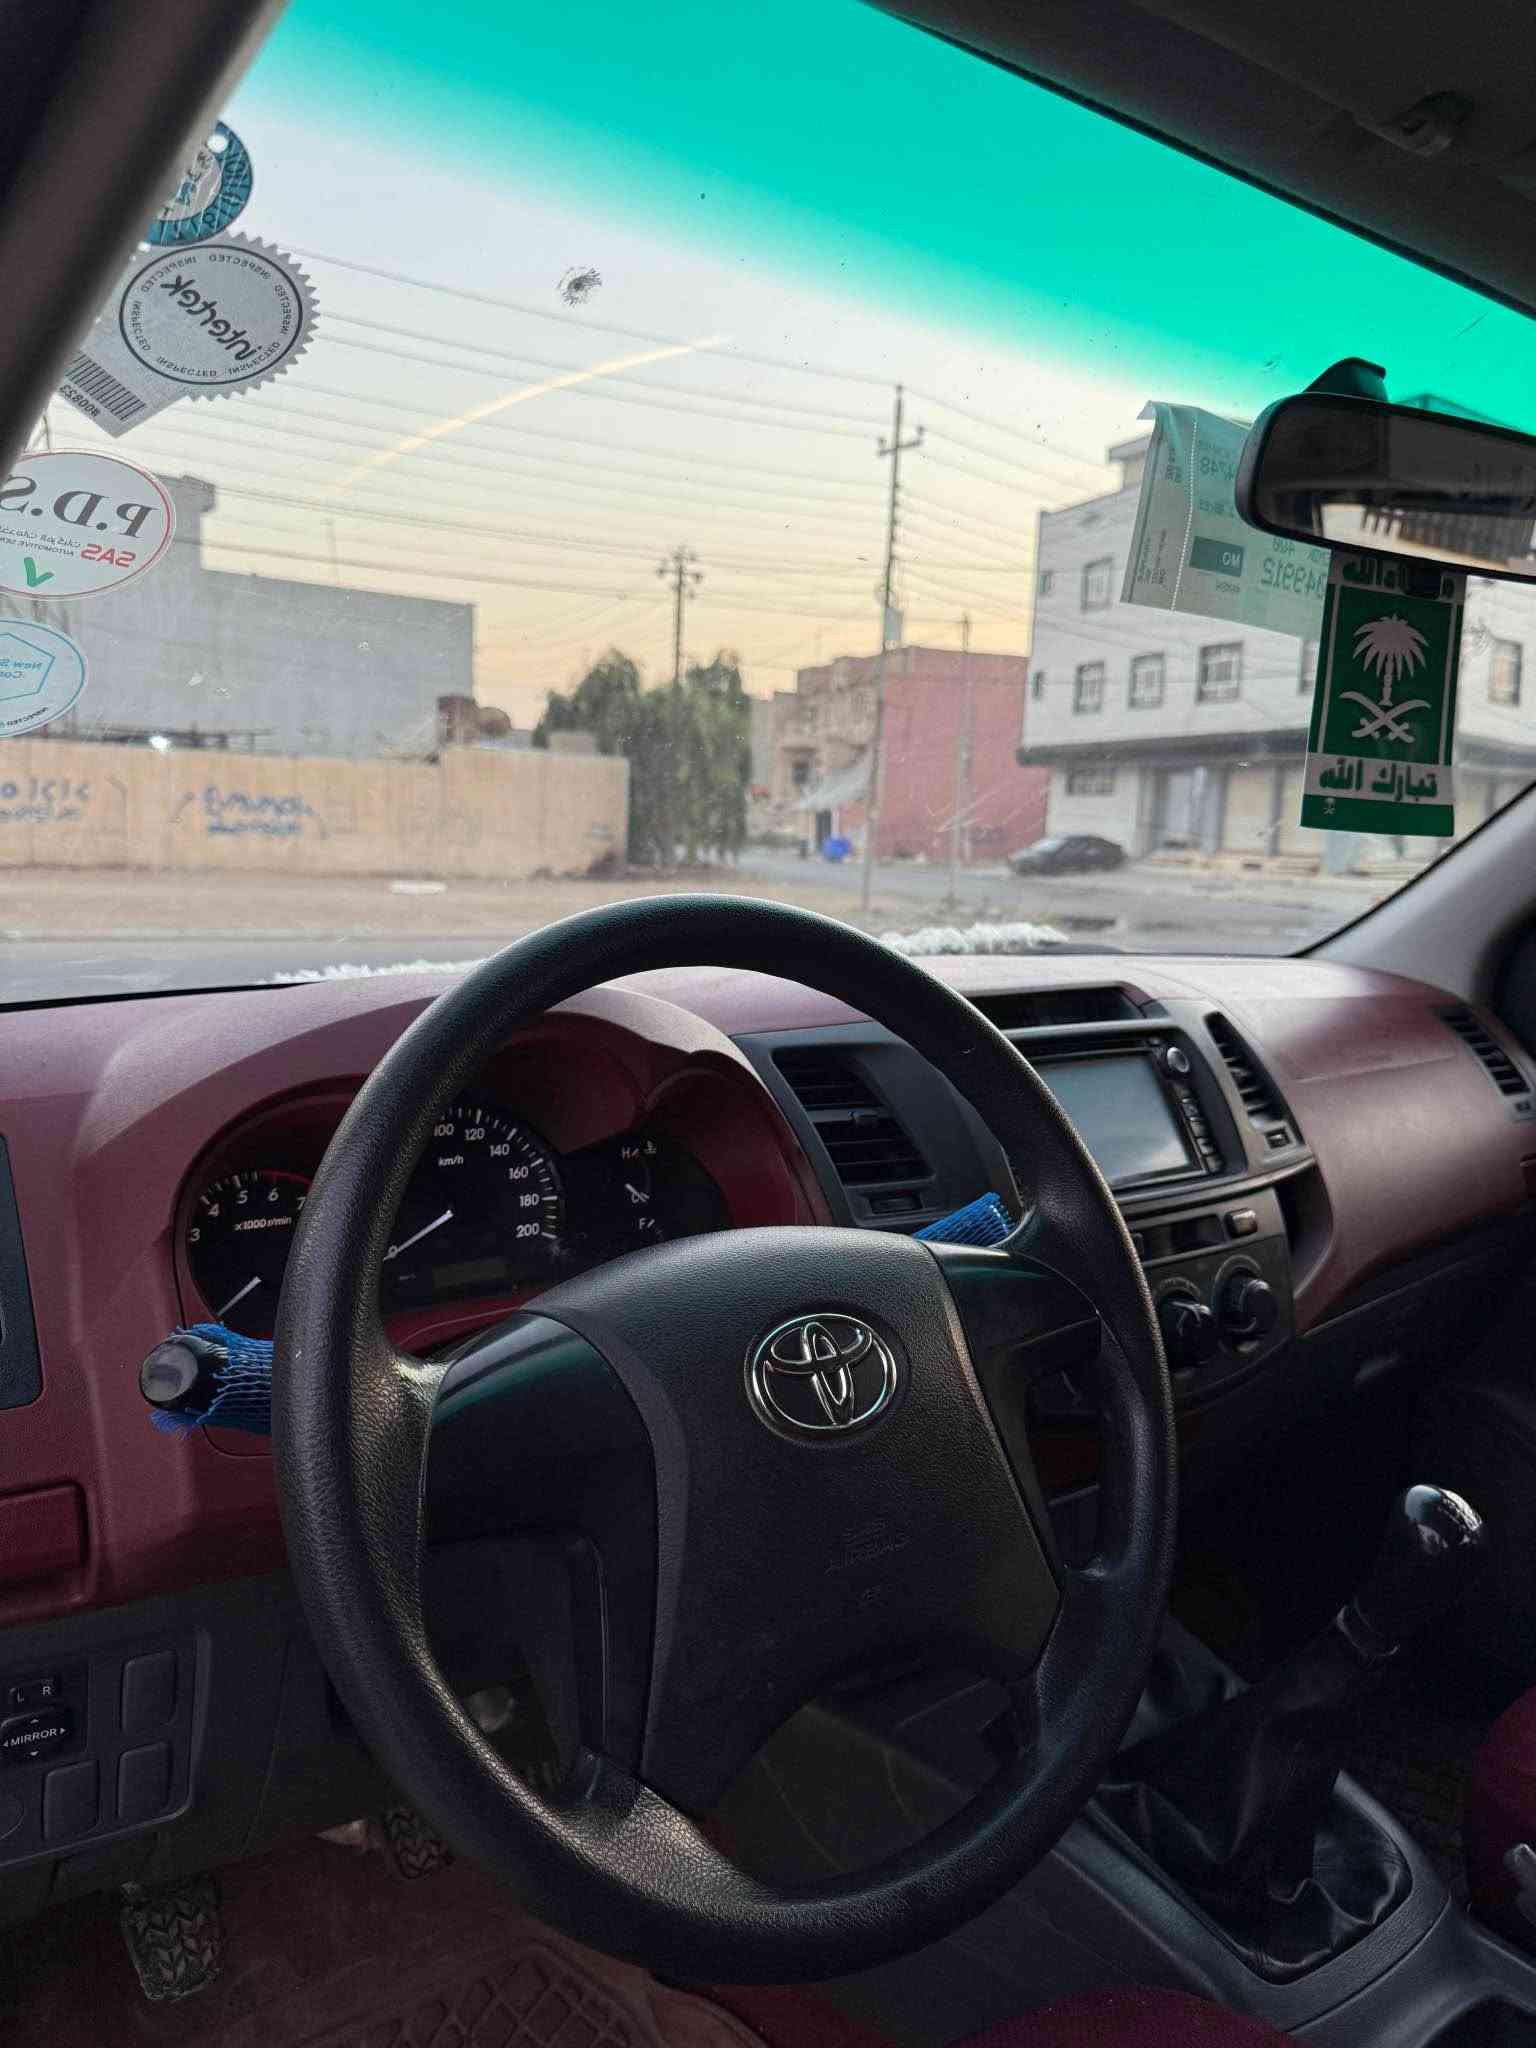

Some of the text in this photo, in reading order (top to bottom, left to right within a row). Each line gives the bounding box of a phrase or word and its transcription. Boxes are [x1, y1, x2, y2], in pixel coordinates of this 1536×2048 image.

[1319, 758, 1438, 802] تبارك الله
[434, 1123, 454, 1137] 100
[464, 1127, 485, 1141] 120
[489, 1143, 510, 1157] 140
[622, 1147, 631, 1160] H
[438, 1155, 464, 1167] km/h
[508, 1166, 529, 1180] 160
[238, 1190, 248, 1204] 5
[268, 1187, 279, 1202] 6
[519, 1193, 540, 1207] 180
[208, 1203, 219, 1217] 4
[297, 1196, 306, 1211] 7
[515, 1222, 540, 1238] 200
[639, 1217, 647, 1230] F
[190, 1227, 200, 1241] 3
[42, 1686, 52, 1696] R
[11, 1728, 57, 1747] MIRROR
